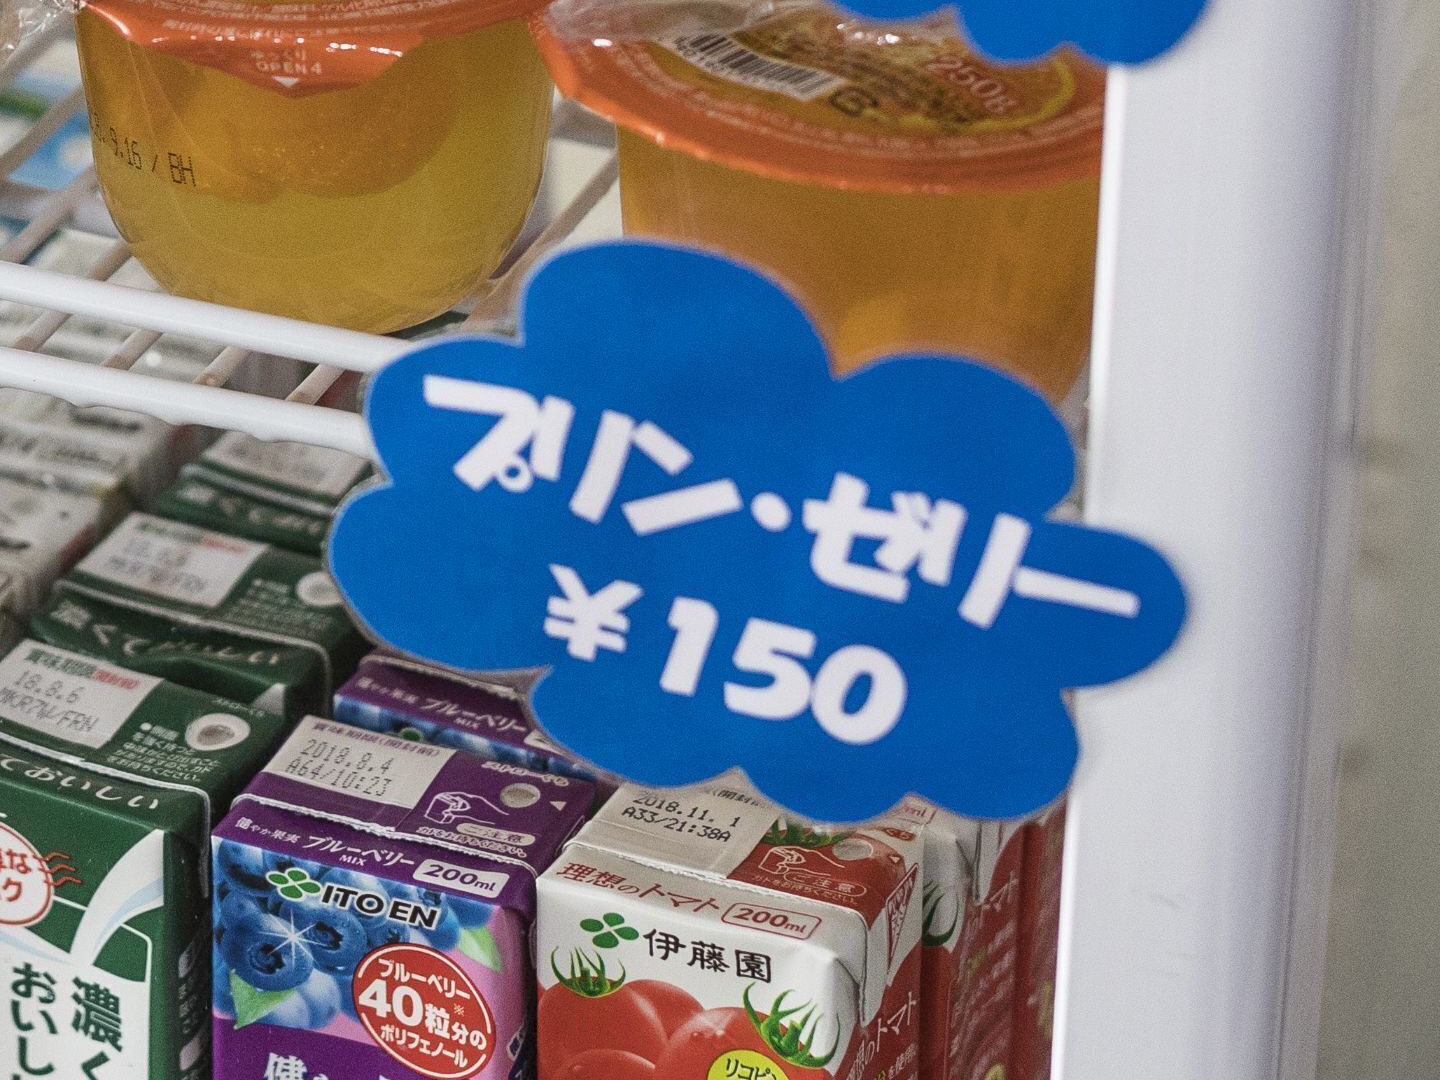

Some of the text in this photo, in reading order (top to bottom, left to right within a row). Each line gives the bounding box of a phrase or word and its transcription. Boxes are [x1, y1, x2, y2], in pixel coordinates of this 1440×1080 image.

[422, 374, 1141, 630] プリン・ゼリー
[543, 563, 907, 746] ¥150
[235, 816, 416, 868] 健やか果実 ブルーベリー
[622, 806, 732, 843] A33/21:38A
[339, 854, 366, 867] MIX
[422, 863, 497, 893] 200ml
[792, 873, 858, 895] ご注意
[320, 882, 440, 931] ITO EN
[556, 858, 721, 915] 理想のトマト
[732, 906, 808, 934] 200ml
[377, 958, 471, 1000] ブルーベリー
[642, 928, 773, 983] 伊藤園
[11, 962, 59, 1080] おいし
[358, 979, 488, 1051] 40粒分の
[380, 1024, 470, 1069] ポリフェノール
[725, 1058, 777, 1080] リコピ
